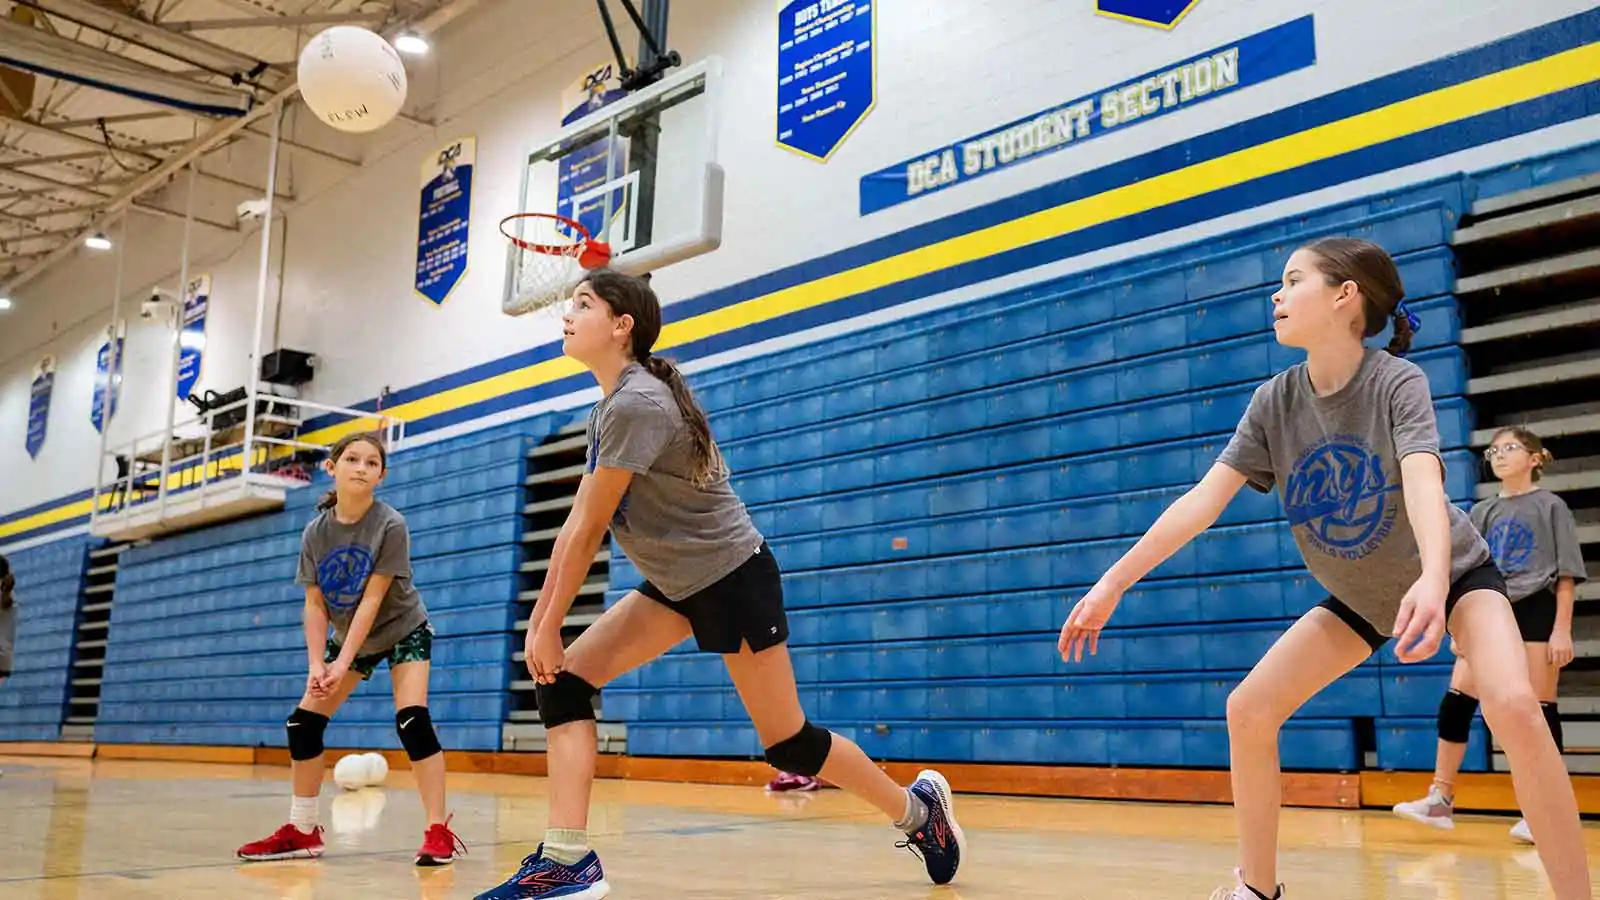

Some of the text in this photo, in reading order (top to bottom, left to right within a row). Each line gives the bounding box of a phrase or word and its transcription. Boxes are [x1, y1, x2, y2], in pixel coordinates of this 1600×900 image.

[907, 47, 1239, 195] DCA STUDENT SECTION
[1340, 503, 1398, 560] VOLLEYBALL
